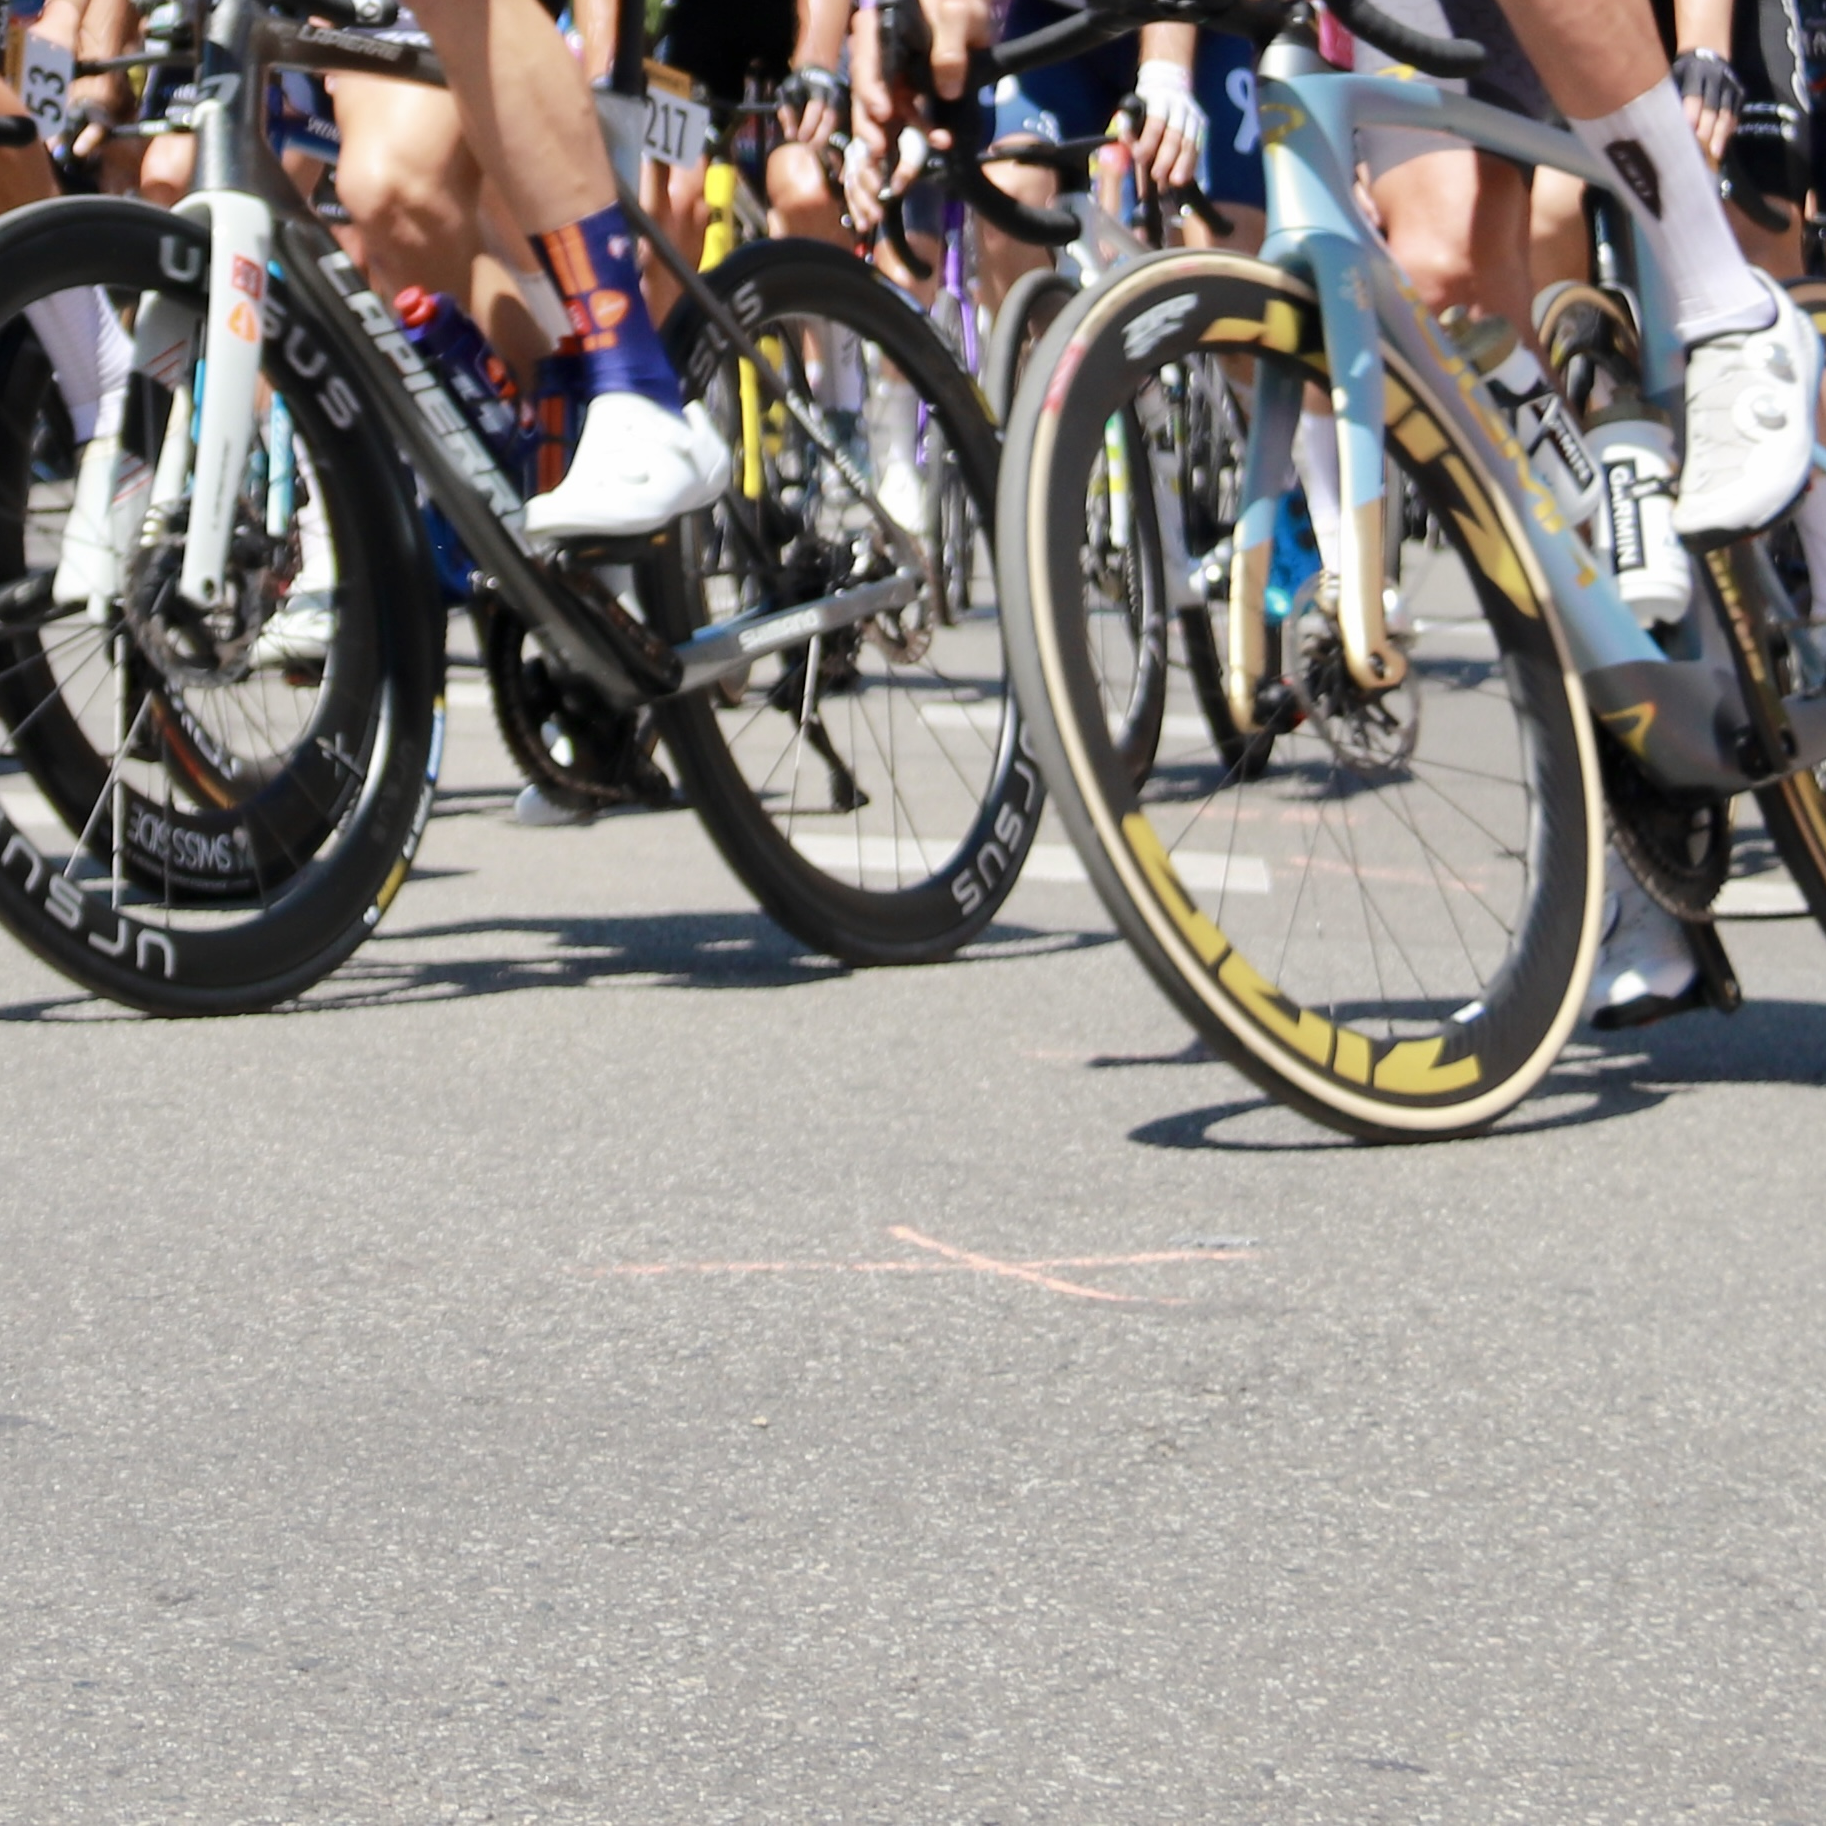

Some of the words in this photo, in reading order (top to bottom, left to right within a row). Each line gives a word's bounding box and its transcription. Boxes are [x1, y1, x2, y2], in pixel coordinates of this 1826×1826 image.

[24, 65, 66, 123] 53
[644, 95, 689, 160] 217
[1608, 464, 1641, 569] GARMIN
